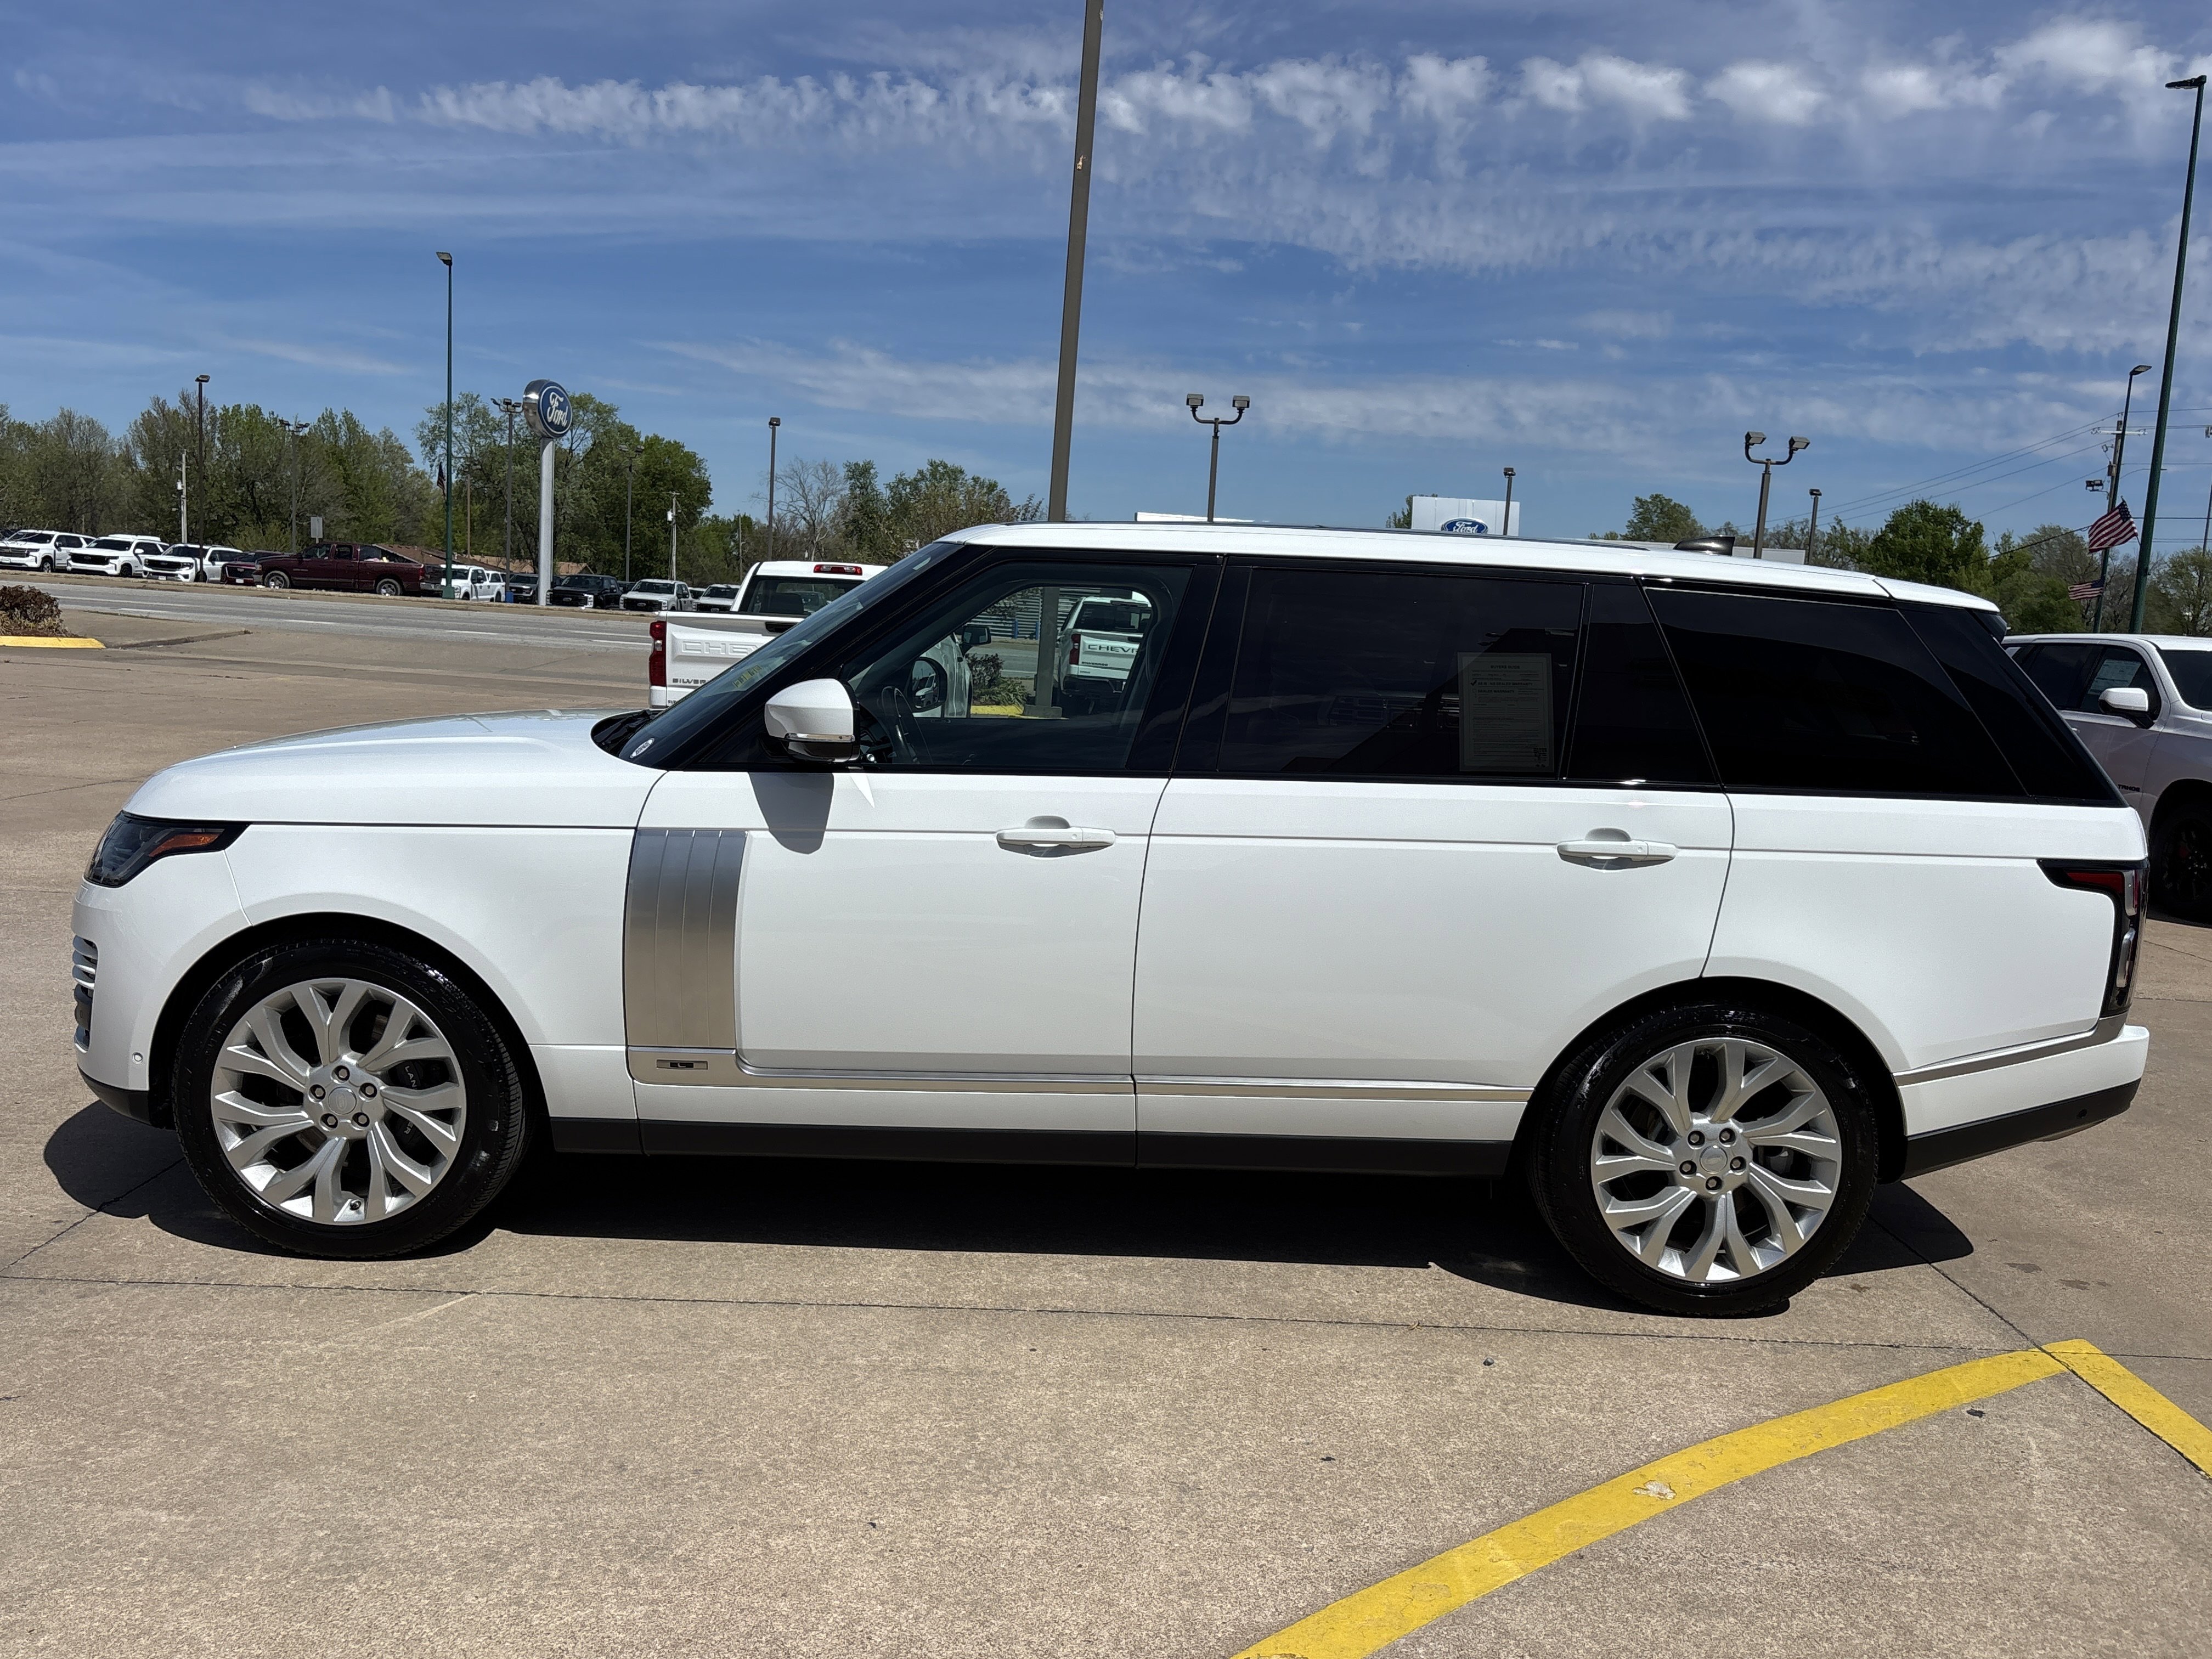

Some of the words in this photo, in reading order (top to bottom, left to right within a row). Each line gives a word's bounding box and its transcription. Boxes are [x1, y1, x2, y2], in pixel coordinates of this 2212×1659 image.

[547, 392, 568, 427] Ford
[1453, 521, 1479, 533] Ford
[2118, 784, 2141, 792] TAHOE
[405, 1065, 417, 1088] LAN
